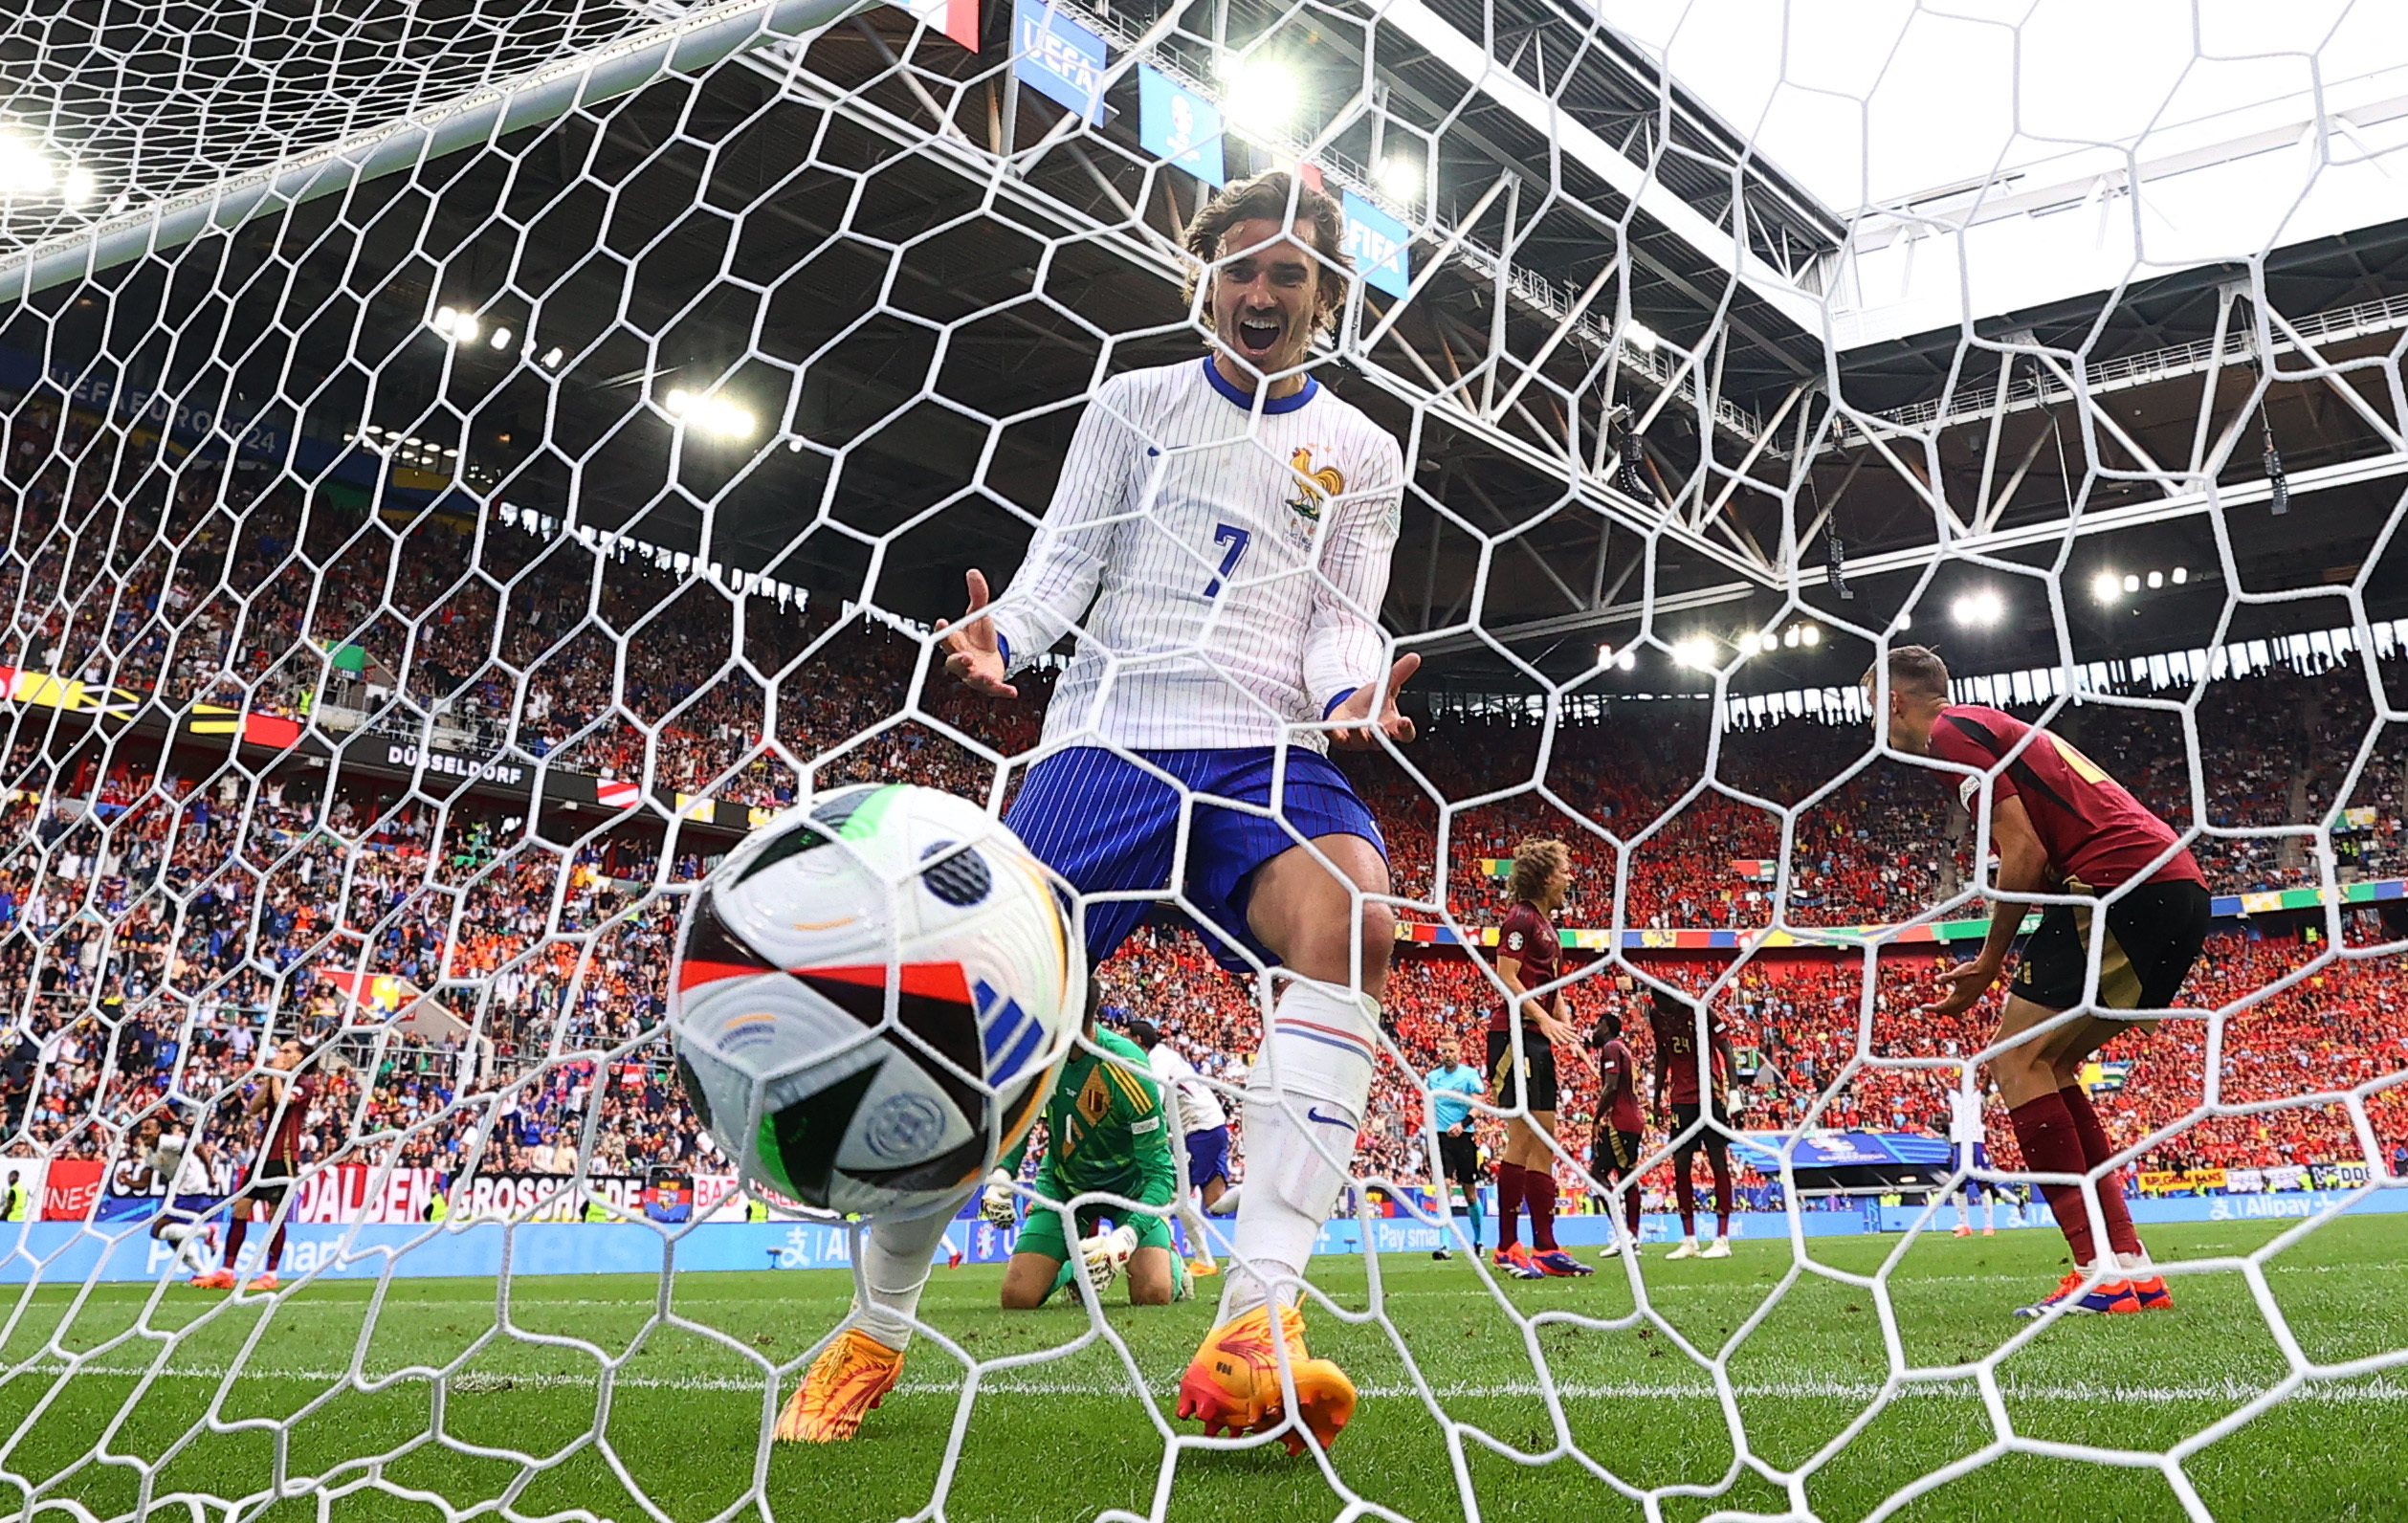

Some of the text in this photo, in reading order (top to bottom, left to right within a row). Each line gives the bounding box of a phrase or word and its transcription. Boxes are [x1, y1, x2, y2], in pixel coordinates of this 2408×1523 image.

[1024, 20, 1094, 93] UEFA
[1349, 218, 1401, 275] FIFA
[129, 392, 212, 433] EURO
[1203, 522, 1251, 599] 7
[387, 744, 522, 785] DÜSSELDORF
[1671, 1036, 1690, 1053] 24
[253, 1163, 433, 1223] DALBEN
[449, 1176, 642, 1222] GROSSHDE
[146, 1239, 227, 1275] Py
[1379, 1223, 1440, 1252] Pay sma
